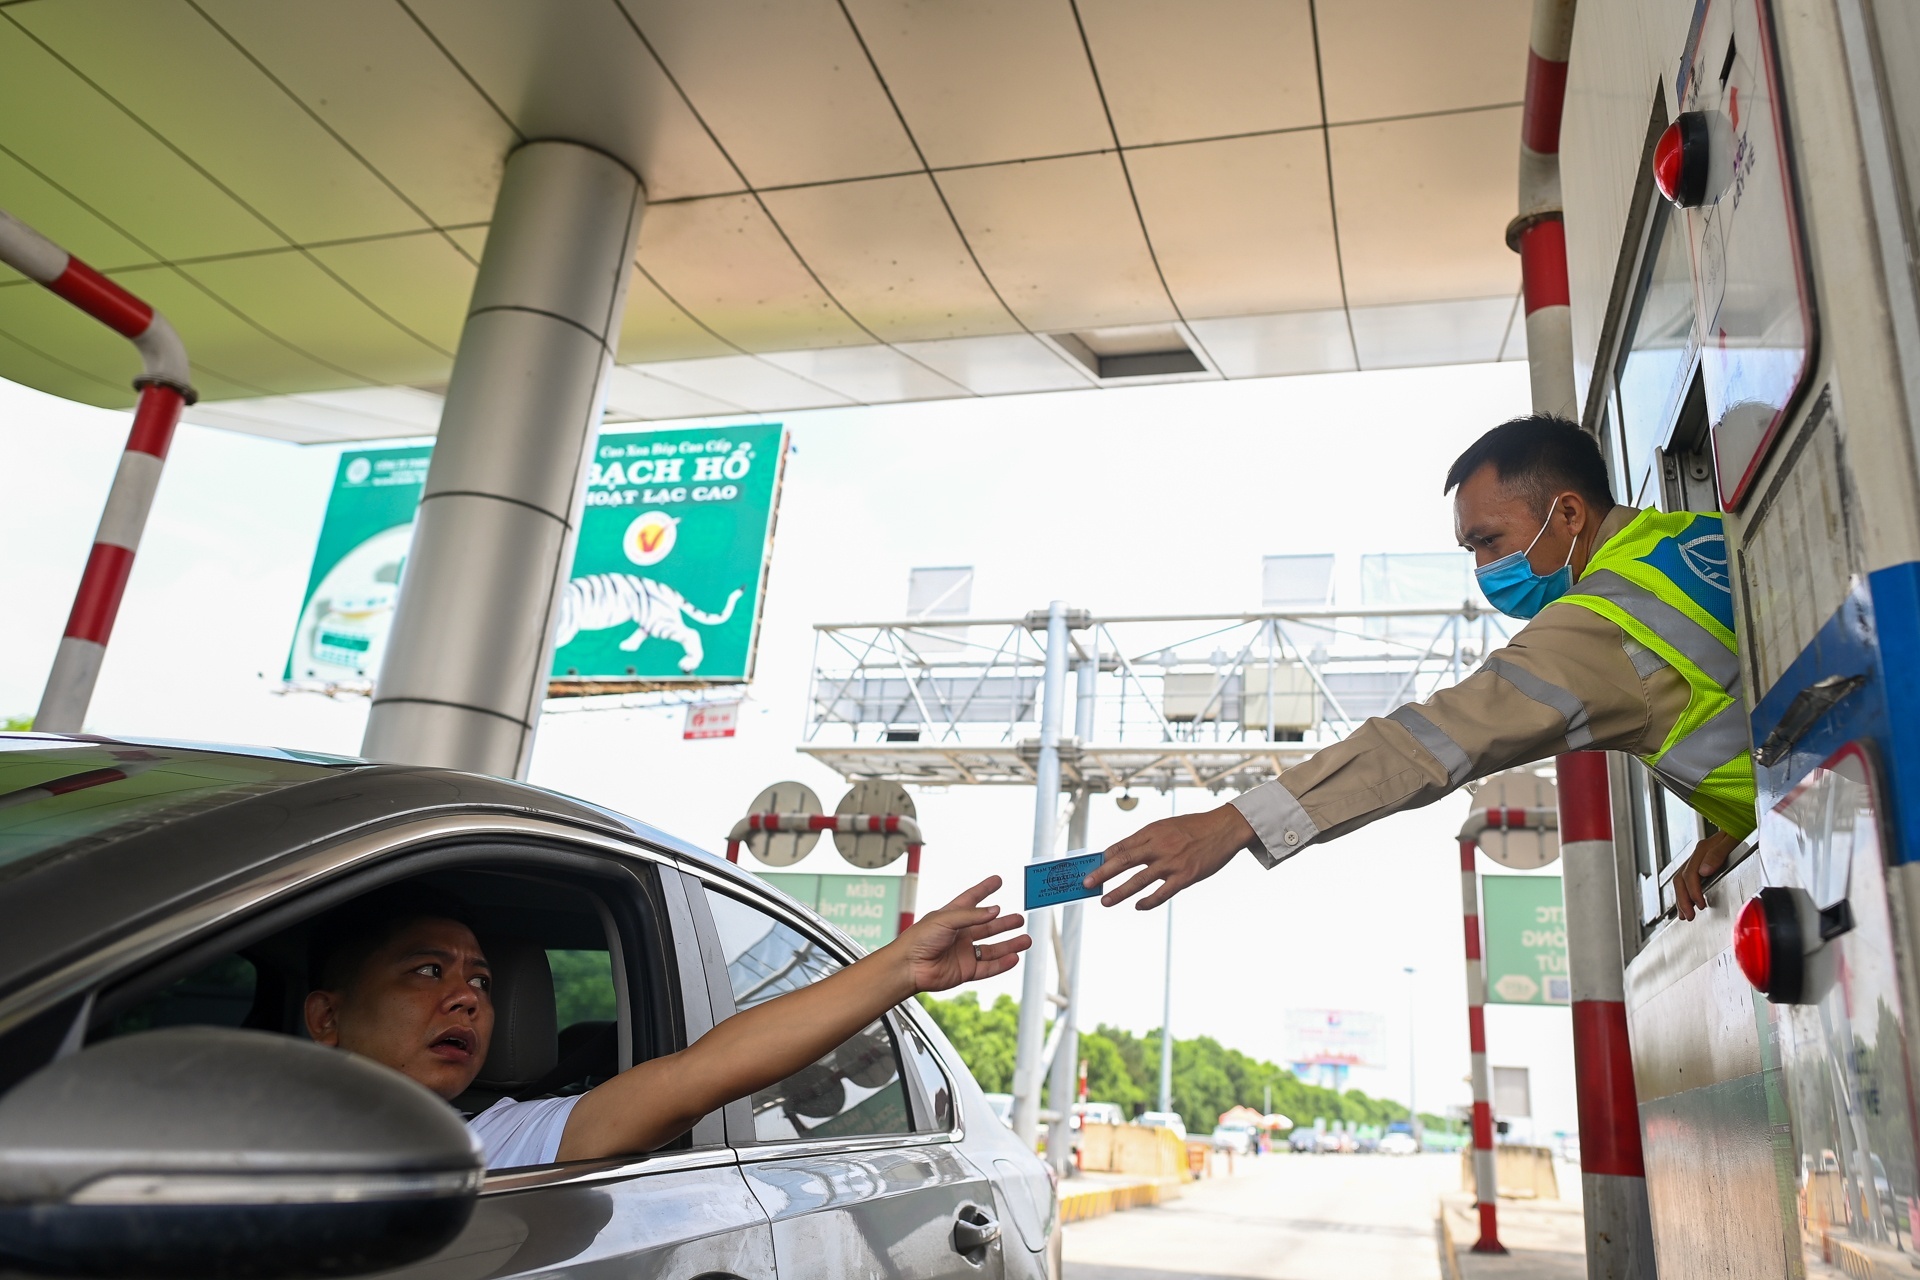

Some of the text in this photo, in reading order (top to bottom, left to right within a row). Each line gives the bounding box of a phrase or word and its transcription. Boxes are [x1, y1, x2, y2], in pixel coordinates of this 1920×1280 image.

[588, 442, 752, 490] BẠCH HỔ
[642, 487, 687, 505] LẠC
[692, 485, 738, 502] CAO
